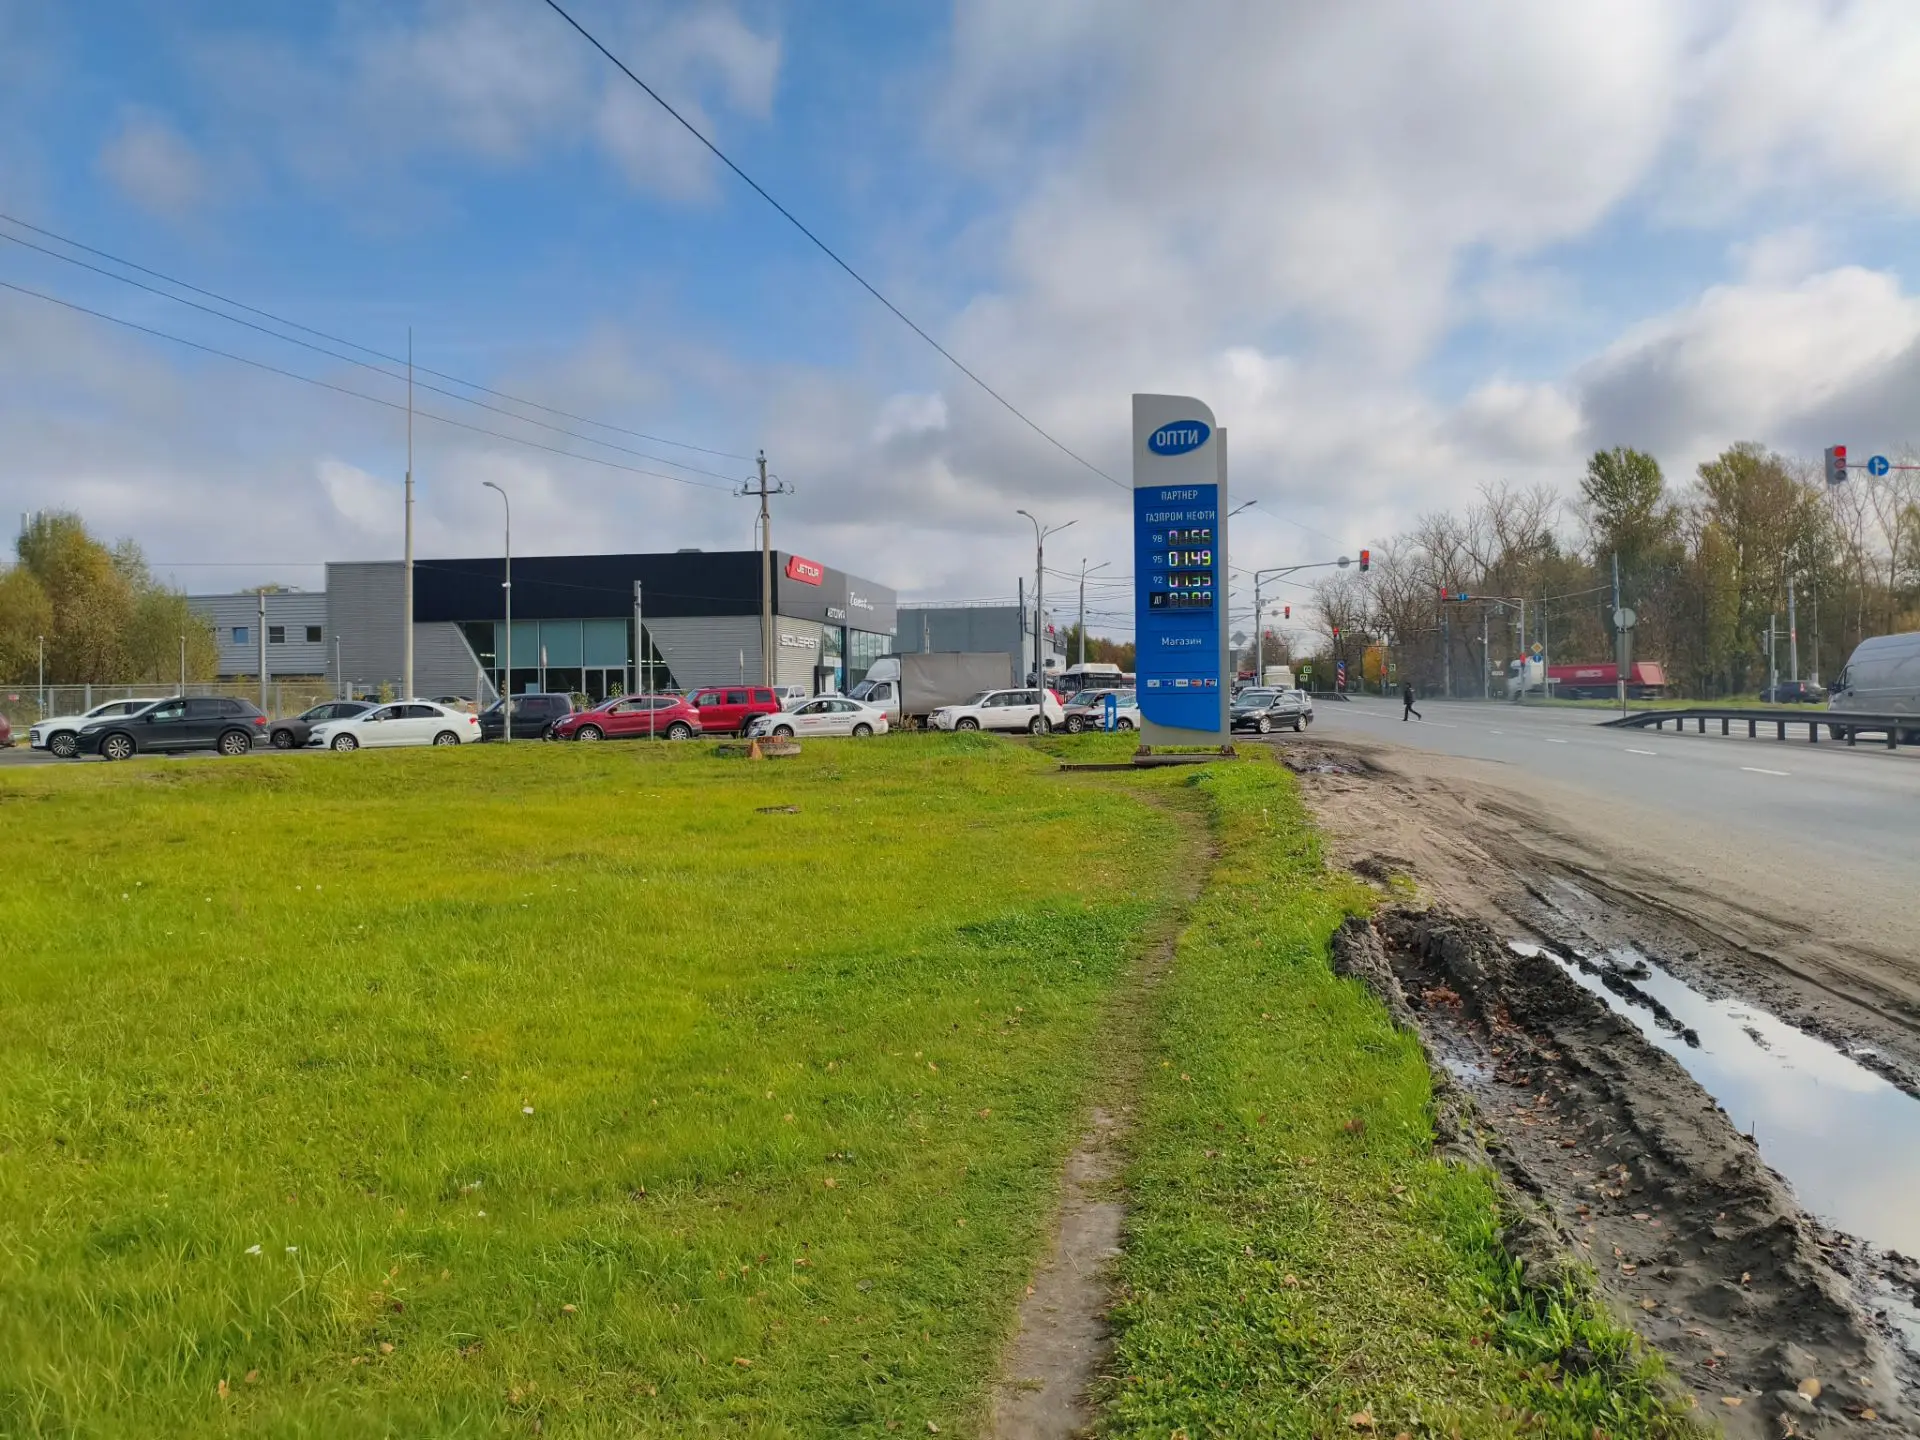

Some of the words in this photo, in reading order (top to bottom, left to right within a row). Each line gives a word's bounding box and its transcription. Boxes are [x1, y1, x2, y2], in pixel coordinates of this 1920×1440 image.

[1156, 430, 1199, 446] ОПТИ
[1161, 490, 1198, 501] ПАРТНЕР
[1145, 512, 1183, 522] ГАЗПРОМ
[1186, 510, 1215, 520] НЕФТИ
[1152, 555, 1163, 563] 95
[796, 563, 819, 577] JETOUR
[1161, 636, 1202, 645] Магазин
